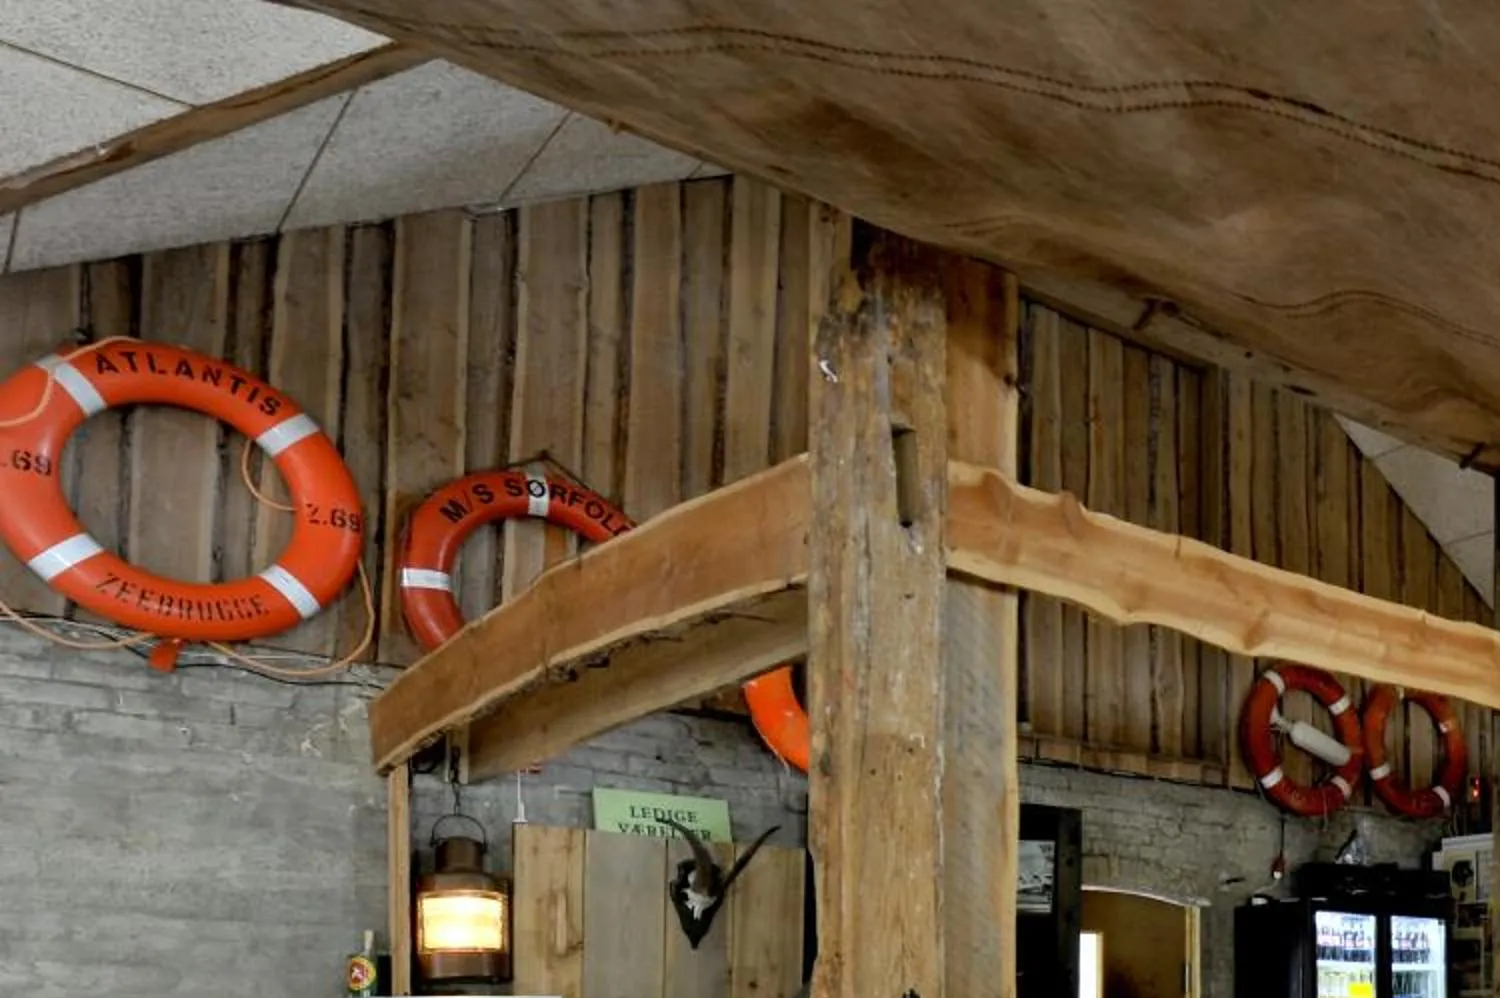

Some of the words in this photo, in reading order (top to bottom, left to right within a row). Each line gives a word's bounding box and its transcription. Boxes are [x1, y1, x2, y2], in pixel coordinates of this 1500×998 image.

[96, 351, 283, 417] ATLANTIS
[440, 483, 495, 524] M/S
[503, 477, 636, 537] SØRFOL
[628, 804, 699, 824] LEDIGE
